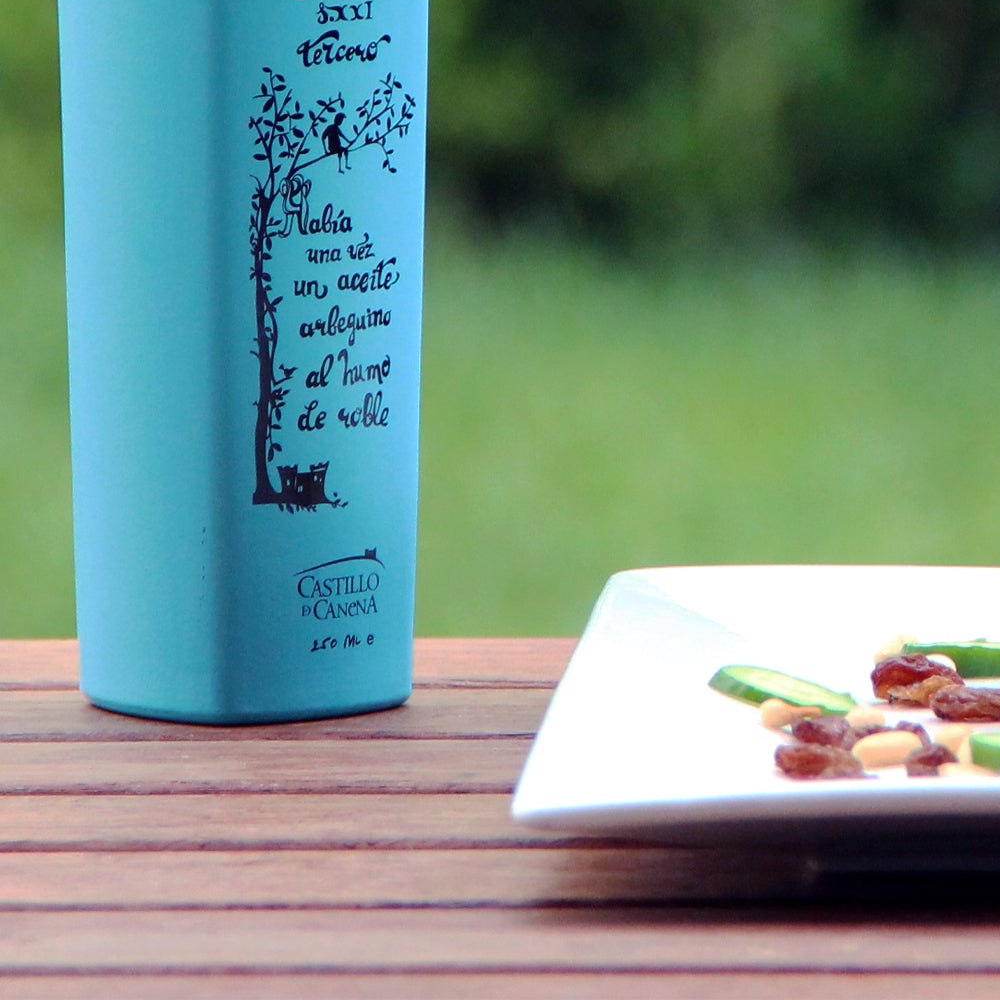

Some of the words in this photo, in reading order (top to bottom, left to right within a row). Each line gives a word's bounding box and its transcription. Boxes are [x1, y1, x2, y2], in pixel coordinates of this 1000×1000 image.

[305, 248, 342, 264] una
[347, 232, 375, 260] vez
[294, 280, 328, 299] un
[337, 257, 400, 293] aceite
[305, 354, 334, 389] al
[337, 348, 391, 386] humo
[297, 400, 327, 431] de
[337, 390, 389, 428] roble
[297, 572, 380, 599] CASTILLO
[310, 636, 337, 652] 250
